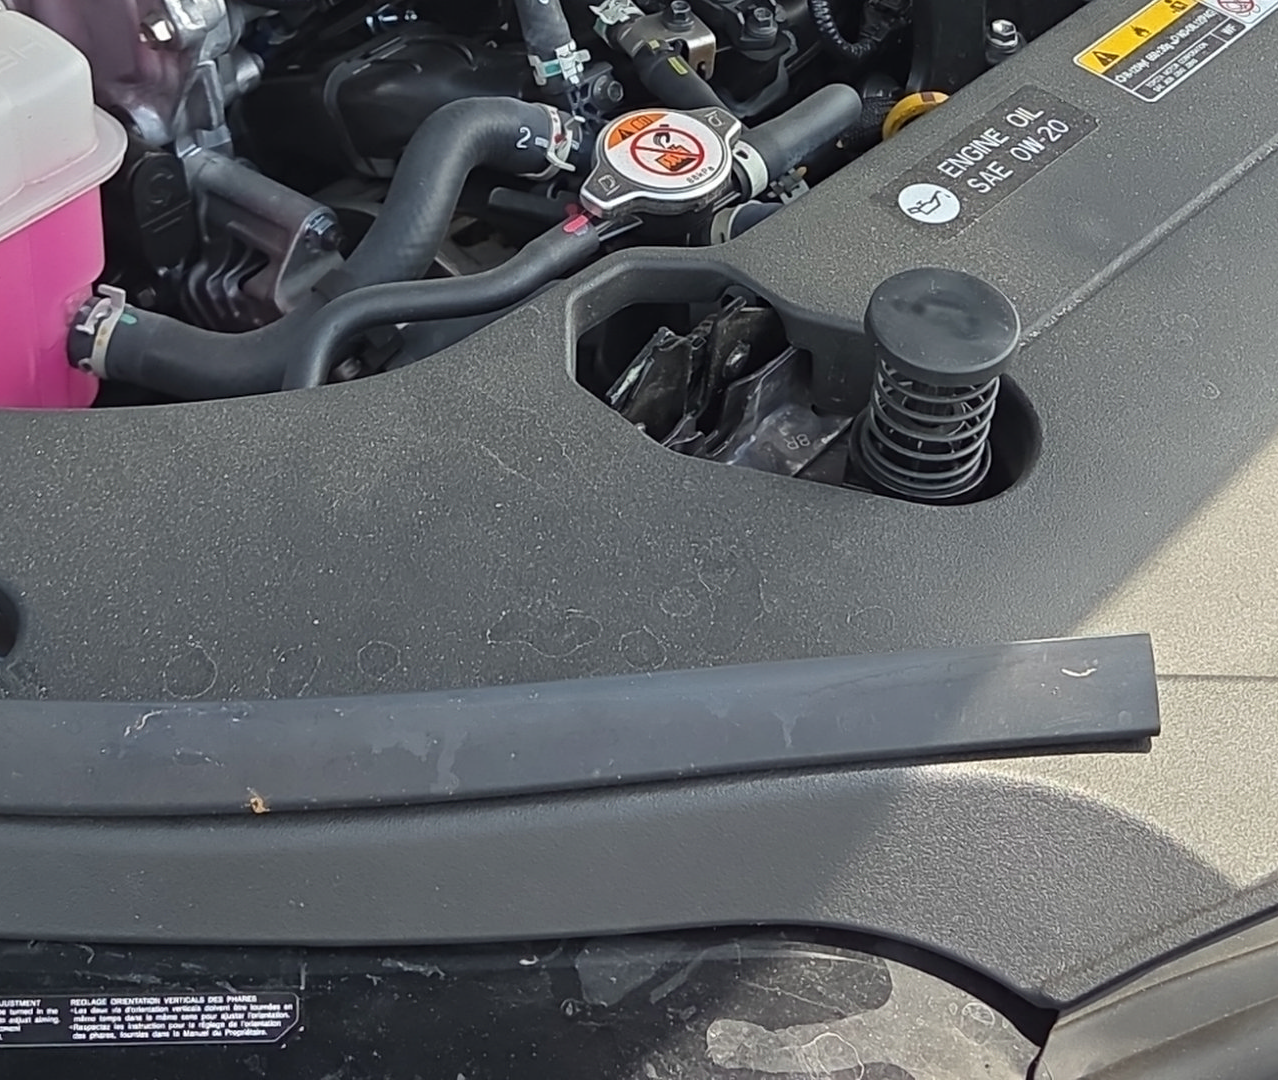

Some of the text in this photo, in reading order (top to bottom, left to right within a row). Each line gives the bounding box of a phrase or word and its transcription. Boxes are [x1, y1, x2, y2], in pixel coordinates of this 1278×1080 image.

[514, 126, 532, 150] 2
[936, 106, 1045, 178] ENGINE OIL
[966, 119, 1069, 194] SAE 0W-20
